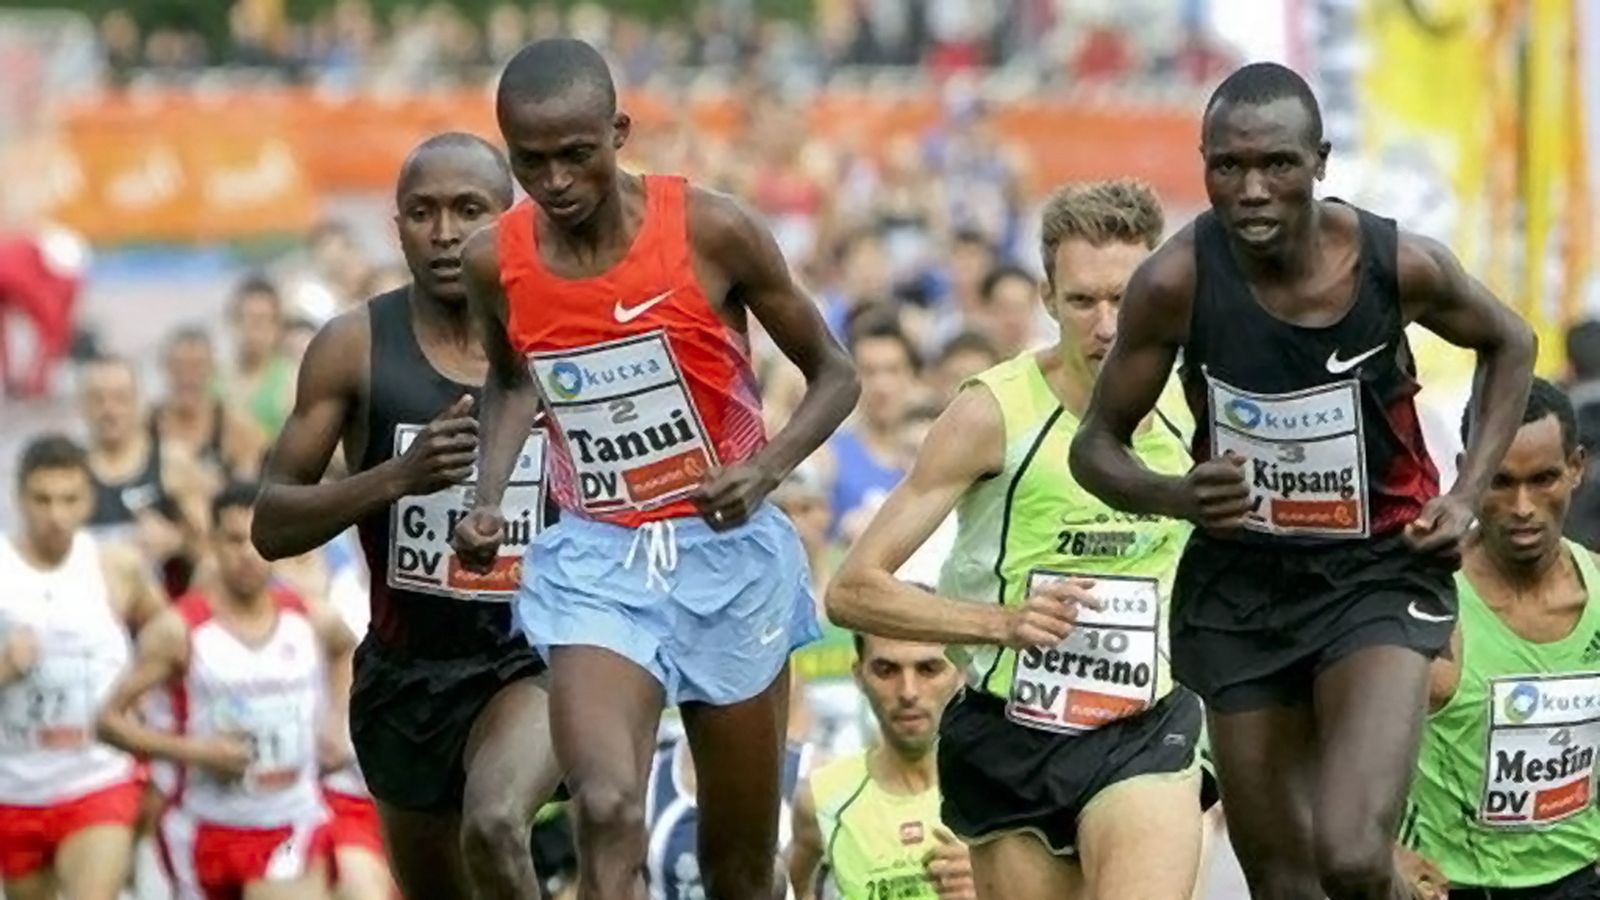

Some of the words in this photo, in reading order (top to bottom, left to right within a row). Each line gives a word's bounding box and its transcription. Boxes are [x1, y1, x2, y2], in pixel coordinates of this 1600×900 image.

[584, 358, 661, 386] kutxa
[608, 400, 640, 424] 2
[1265, 407, 1344, 428] kutxa
[568, 409, 695, 463] Tanui
[1278, 446, 1306, 463] 3
[579, 471, 617, 499] DV
[1252, 458, 1355, 498] Kipsang
[402, 505, 436, 541] G.
[1057, 530, 1086, 556] 26
[398, 547, 442, 575] DV
[1086, 630, 1129, 653] 10
[1022, 645, 1150, 688] Serrano
[1016, 680, 1061, 710] DV
[1543, 693, 1600, 711] kutx
[1494, 744, 1594, 783] Mesfin
[1487, 790, 1530, 813] DV
